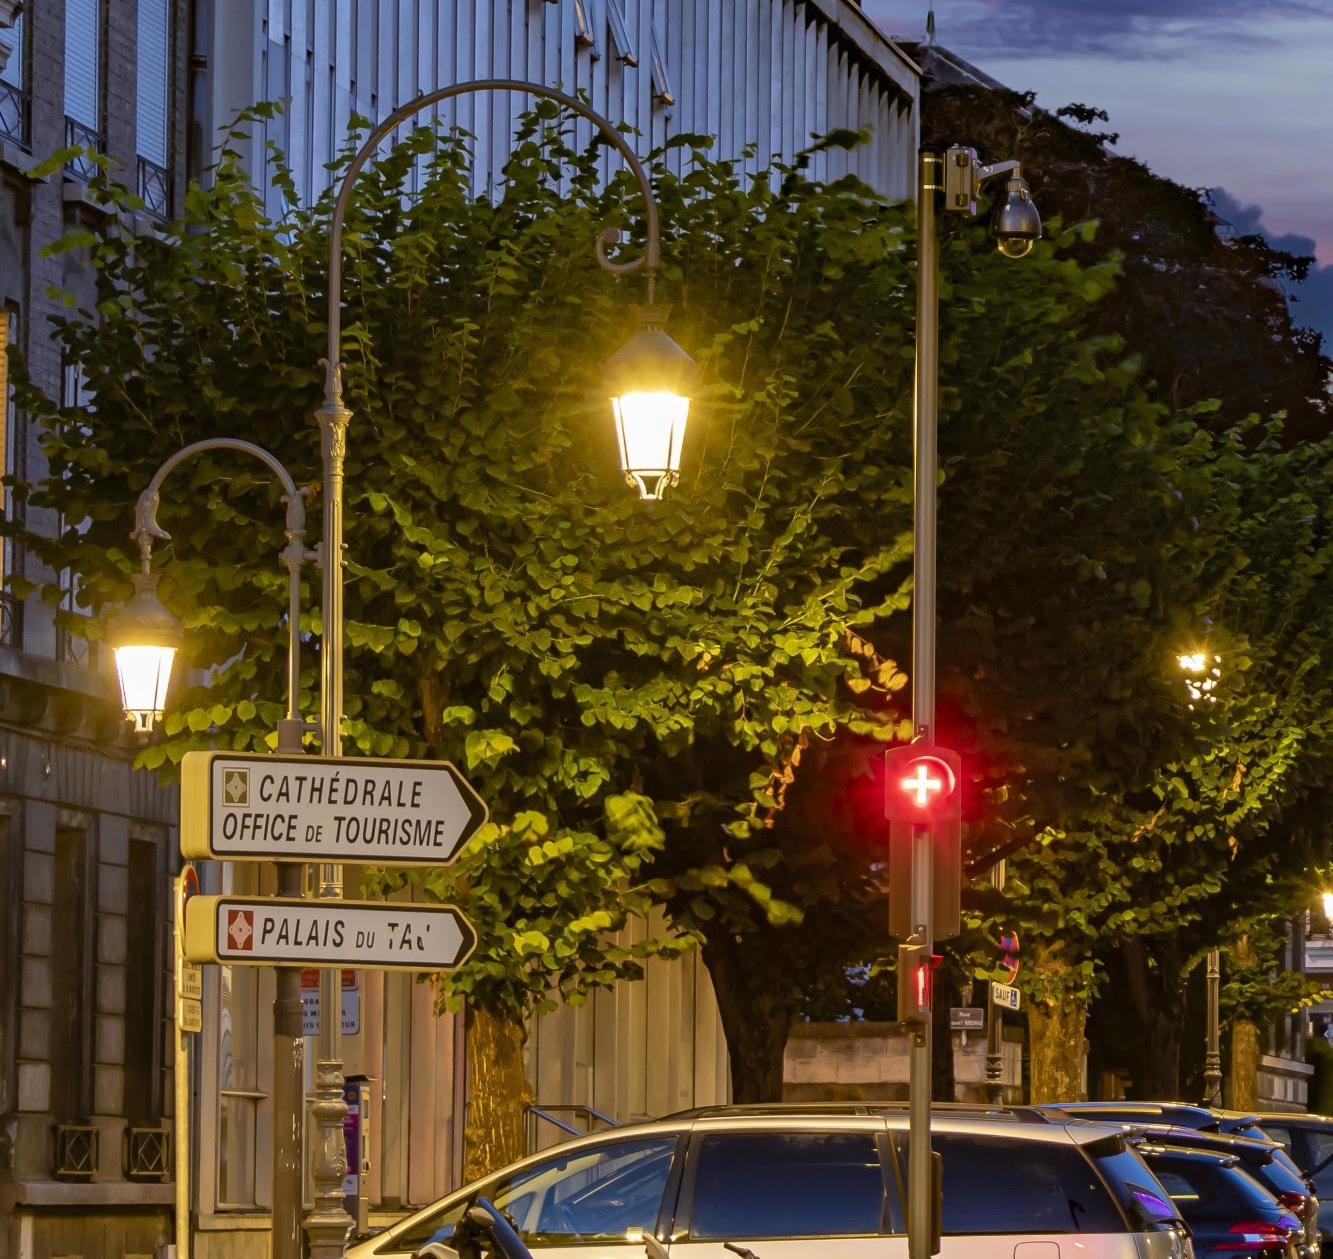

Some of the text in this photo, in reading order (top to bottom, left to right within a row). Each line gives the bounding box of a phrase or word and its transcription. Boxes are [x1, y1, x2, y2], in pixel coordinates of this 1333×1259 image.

[259, 771, 423, 808] CATHÉDRALE
[222, 812, 446, 847] OFFICE DE TOURISME
[261, 917, 345, 947] PALAIS
[356, 930, 375, 949] DU
[995, 988, 1010, 1001] SAUF
